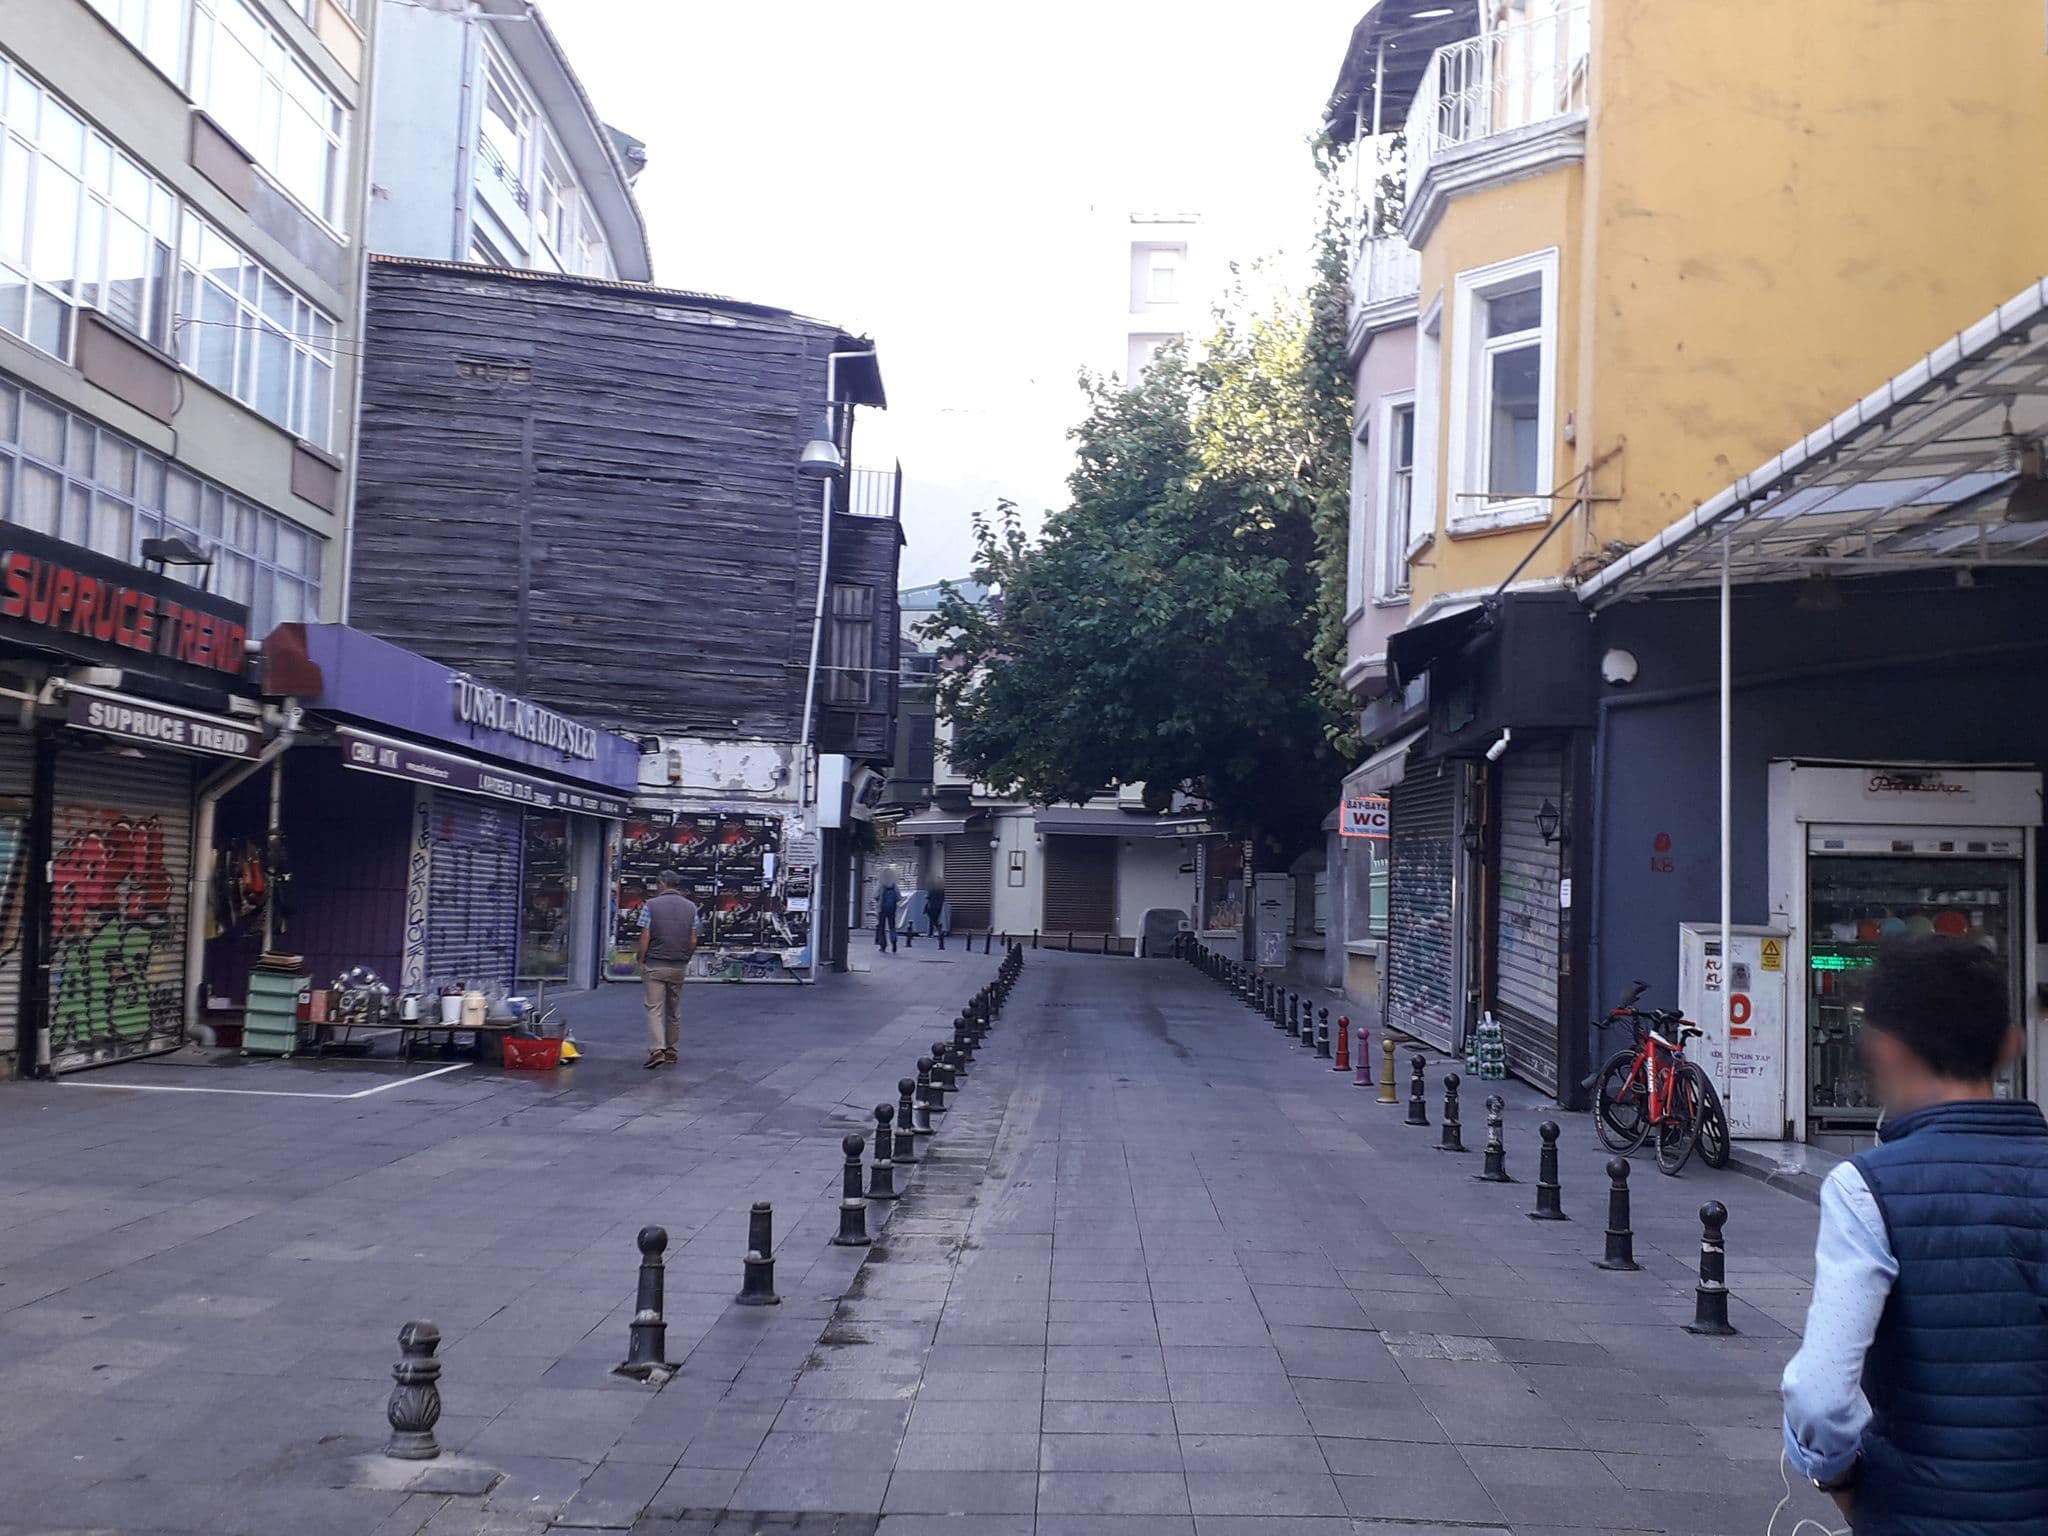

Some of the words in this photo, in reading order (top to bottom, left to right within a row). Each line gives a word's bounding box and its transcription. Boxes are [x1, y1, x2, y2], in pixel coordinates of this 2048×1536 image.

[2, 551, 157, 653] SUPRUCE
[157, 597, 246, 676] TREND
[88, 702, 185, 742] SUPRUCE
[190, 723, 249, 753] TREND
[1353, 812, 1386, 827] WC
